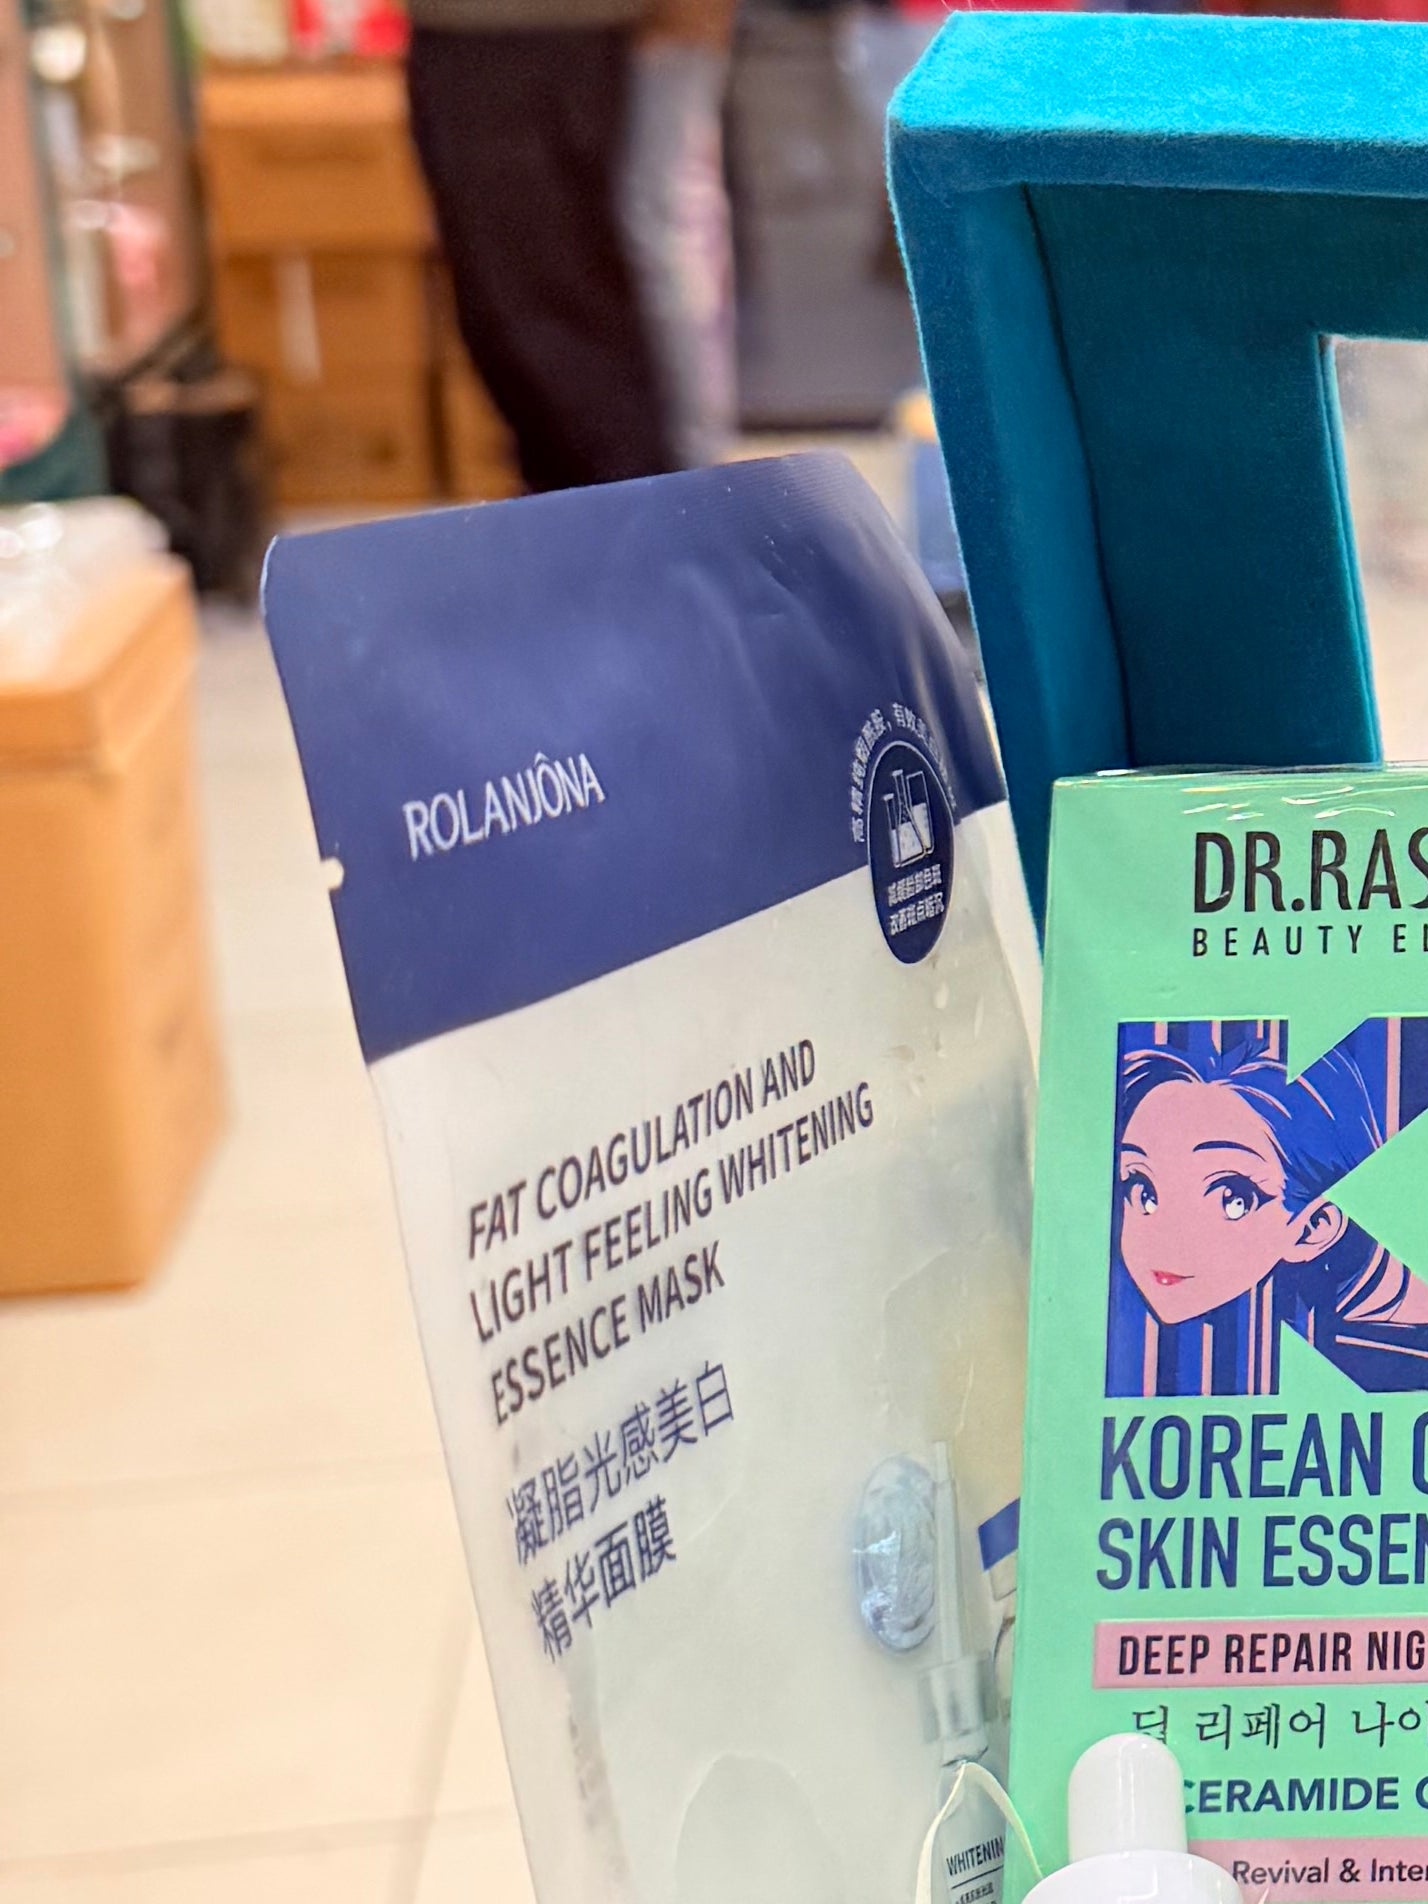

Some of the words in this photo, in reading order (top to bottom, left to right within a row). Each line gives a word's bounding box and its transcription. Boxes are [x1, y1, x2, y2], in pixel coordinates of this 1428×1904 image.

[1193, 922, 1363, 958] BEAUTY
[468, 1180, 528, 1260] FAT
[536, 1067, 754, 1220] COAGULATION
[762, 1038, 817, 1109] AND
[469, 1239, 575, 1345] LIGHT
[583, 1167, 714, 1283] FEELING
[718, 1080, 876, 1206] WHITENING
[490, 1293, 632, 1427] ESSENCE
[638, 1240, 726, 1336] MASK
[506, 1360, 735, 1567] 凝脂光感美白
[1099, 1411, 1383, 1501] KOREAN
[532, 1494, 678, 1664] 精华面膜
[1096, 1516, 1240, 1590] SKIN
[1118, 1632, 1211, 1676] DEEP
[1225, 1630, 1353, 1673] REPAIR
[1195, 1701, 1327, 1751] 리페어
[1232, 1857, 1330, 1887] Revival
[1339, 1857, 1362, 1884] &
